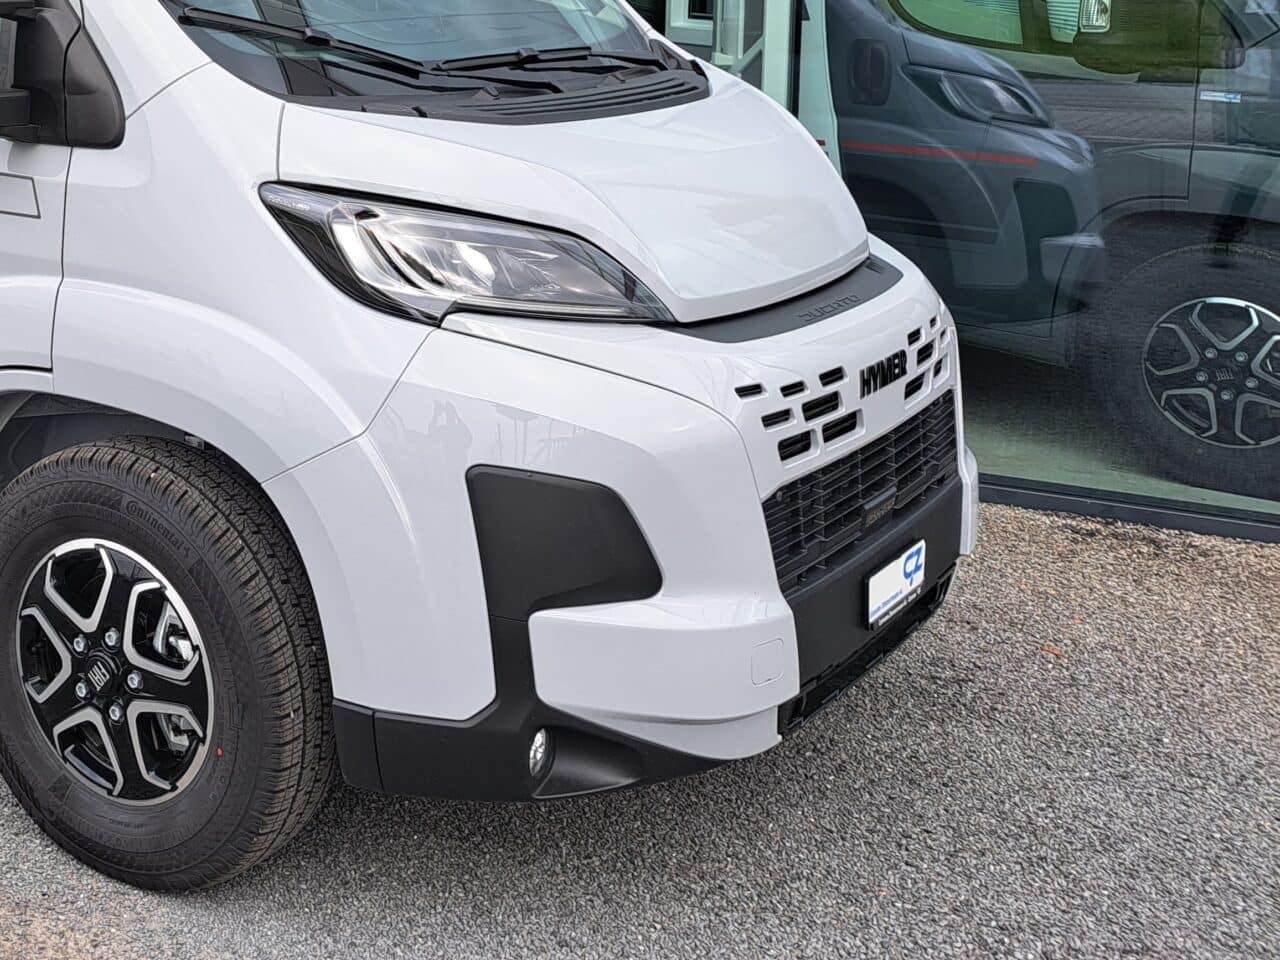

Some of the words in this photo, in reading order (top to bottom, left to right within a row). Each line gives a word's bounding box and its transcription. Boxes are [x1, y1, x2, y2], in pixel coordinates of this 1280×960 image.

[798, 294, 861, 322] DUCATO
[859, 349, 907, 400] HYMER
[126, 500, 184, 550] Continental
[87, 661, 110, 692] FIAT
